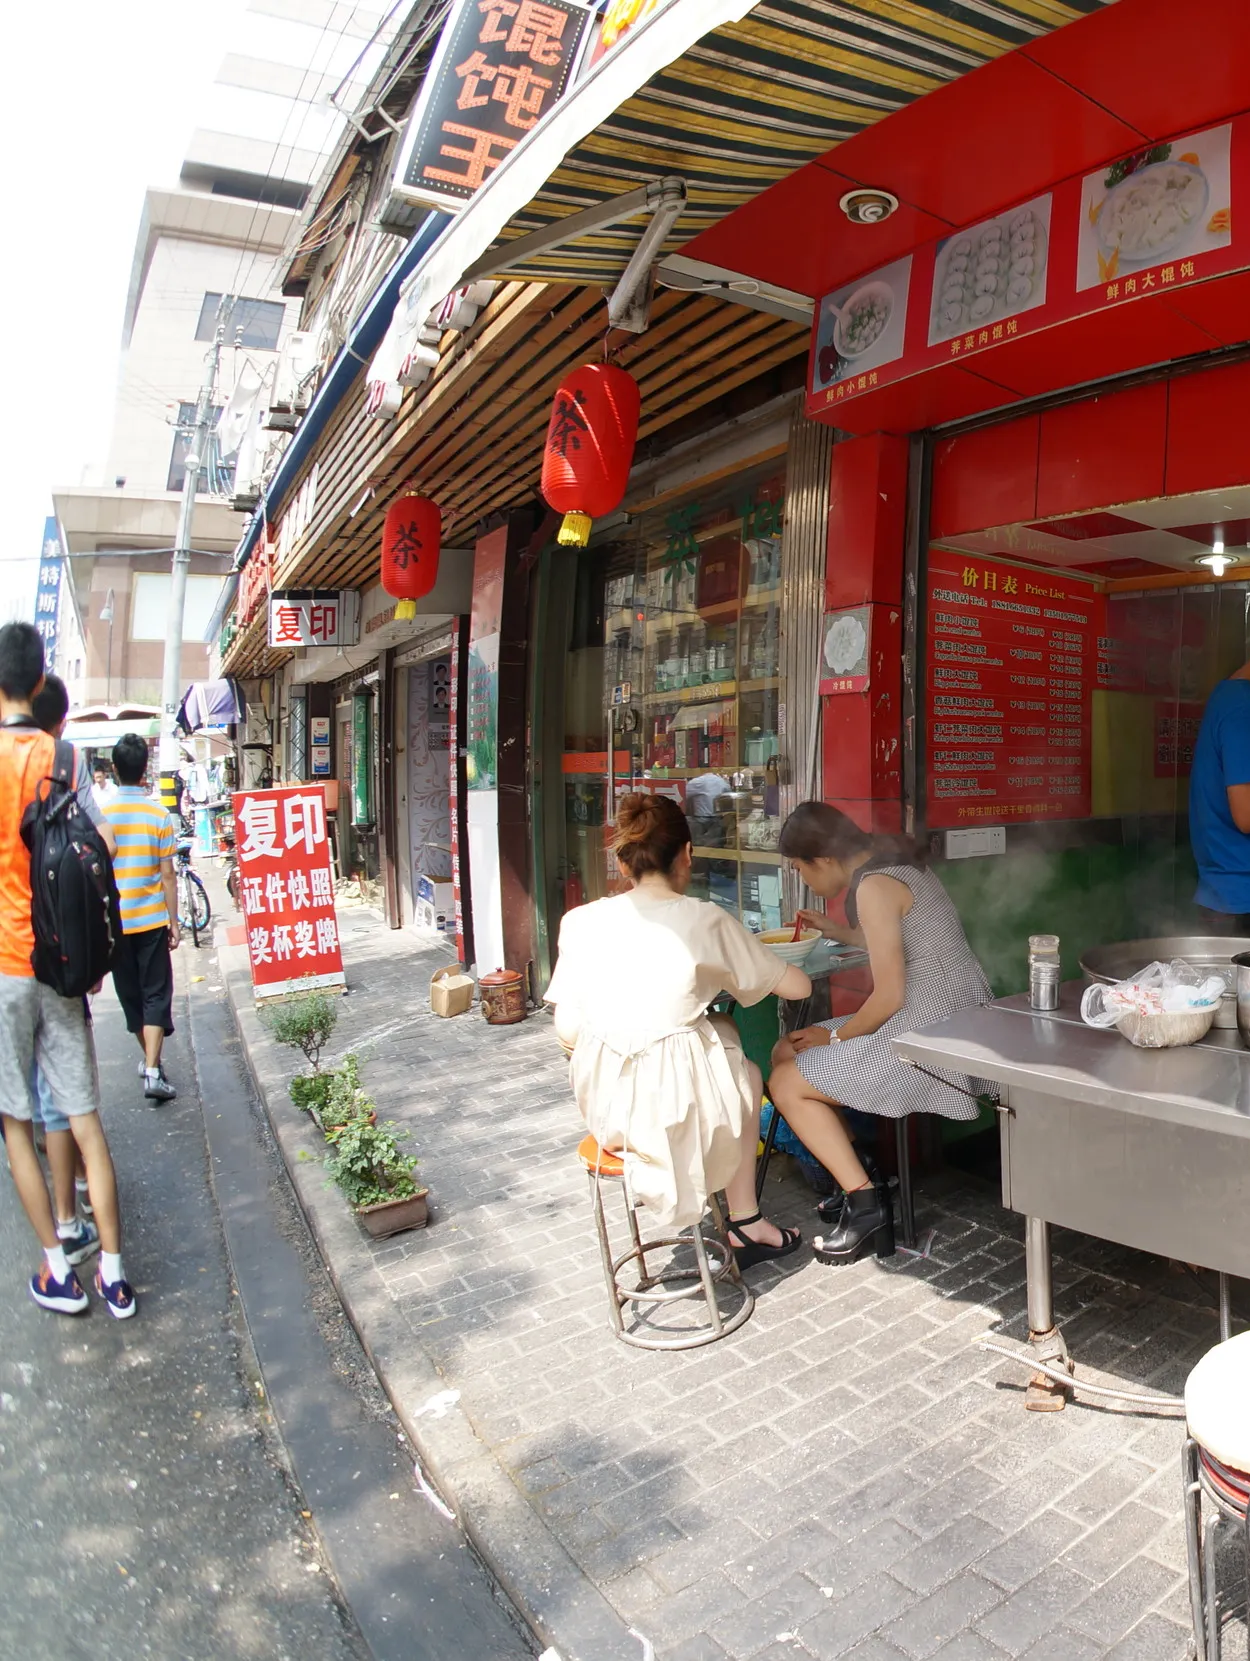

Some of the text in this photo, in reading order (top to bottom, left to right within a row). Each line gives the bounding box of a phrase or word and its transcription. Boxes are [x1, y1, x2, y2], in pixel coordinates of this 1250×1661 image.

[423, 0, 568, 190] 馄饨王
[1106, 261, 1195, 300] 鲜肉大馄饨
[951, 319, 1018, 355] 荠菜肉馄饨
[825, 372, 878, 403] 鲜肉小馄饨
[551, 389, 589, 459] 茶
[391, 520, 423, 569] 茶
[962, 566, 1065, 600] 价目表 Price List
[275, 605, 336, 643] 复印
[934, 668, 978, 681] 鲜肉大馄饨
[238, 793, 325, 863] 复印
[243, 867, 334, 916] 证件快照
[250, 917, 339, 966] 奖杯奖牌
